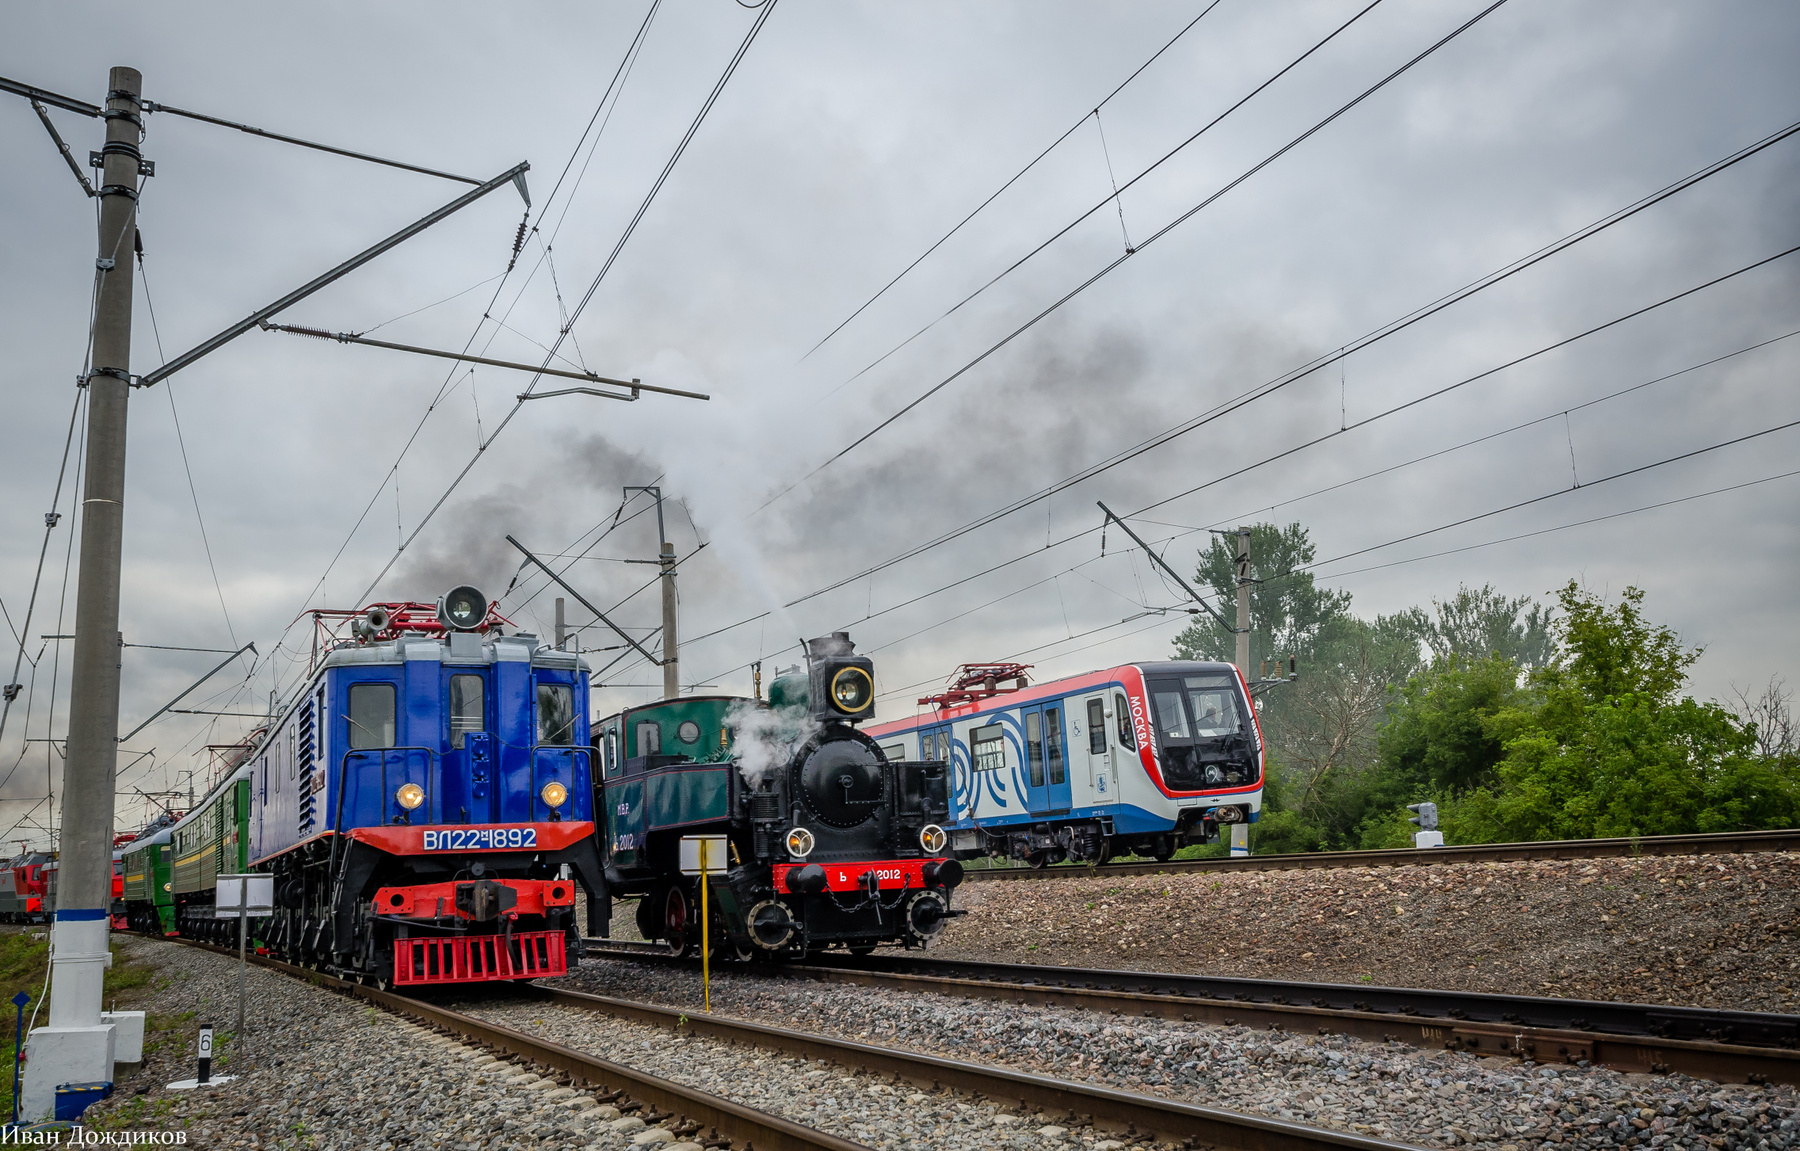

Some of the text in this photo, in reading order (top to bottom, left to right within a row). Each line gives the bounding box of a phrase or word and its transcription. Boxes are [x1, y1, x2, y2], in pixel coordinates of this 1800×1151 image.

[1130, 695, 1149, 750] МОСКВА
[876, 869, 901, 880] 2012
[200, 1034, 211, 1051] 6
